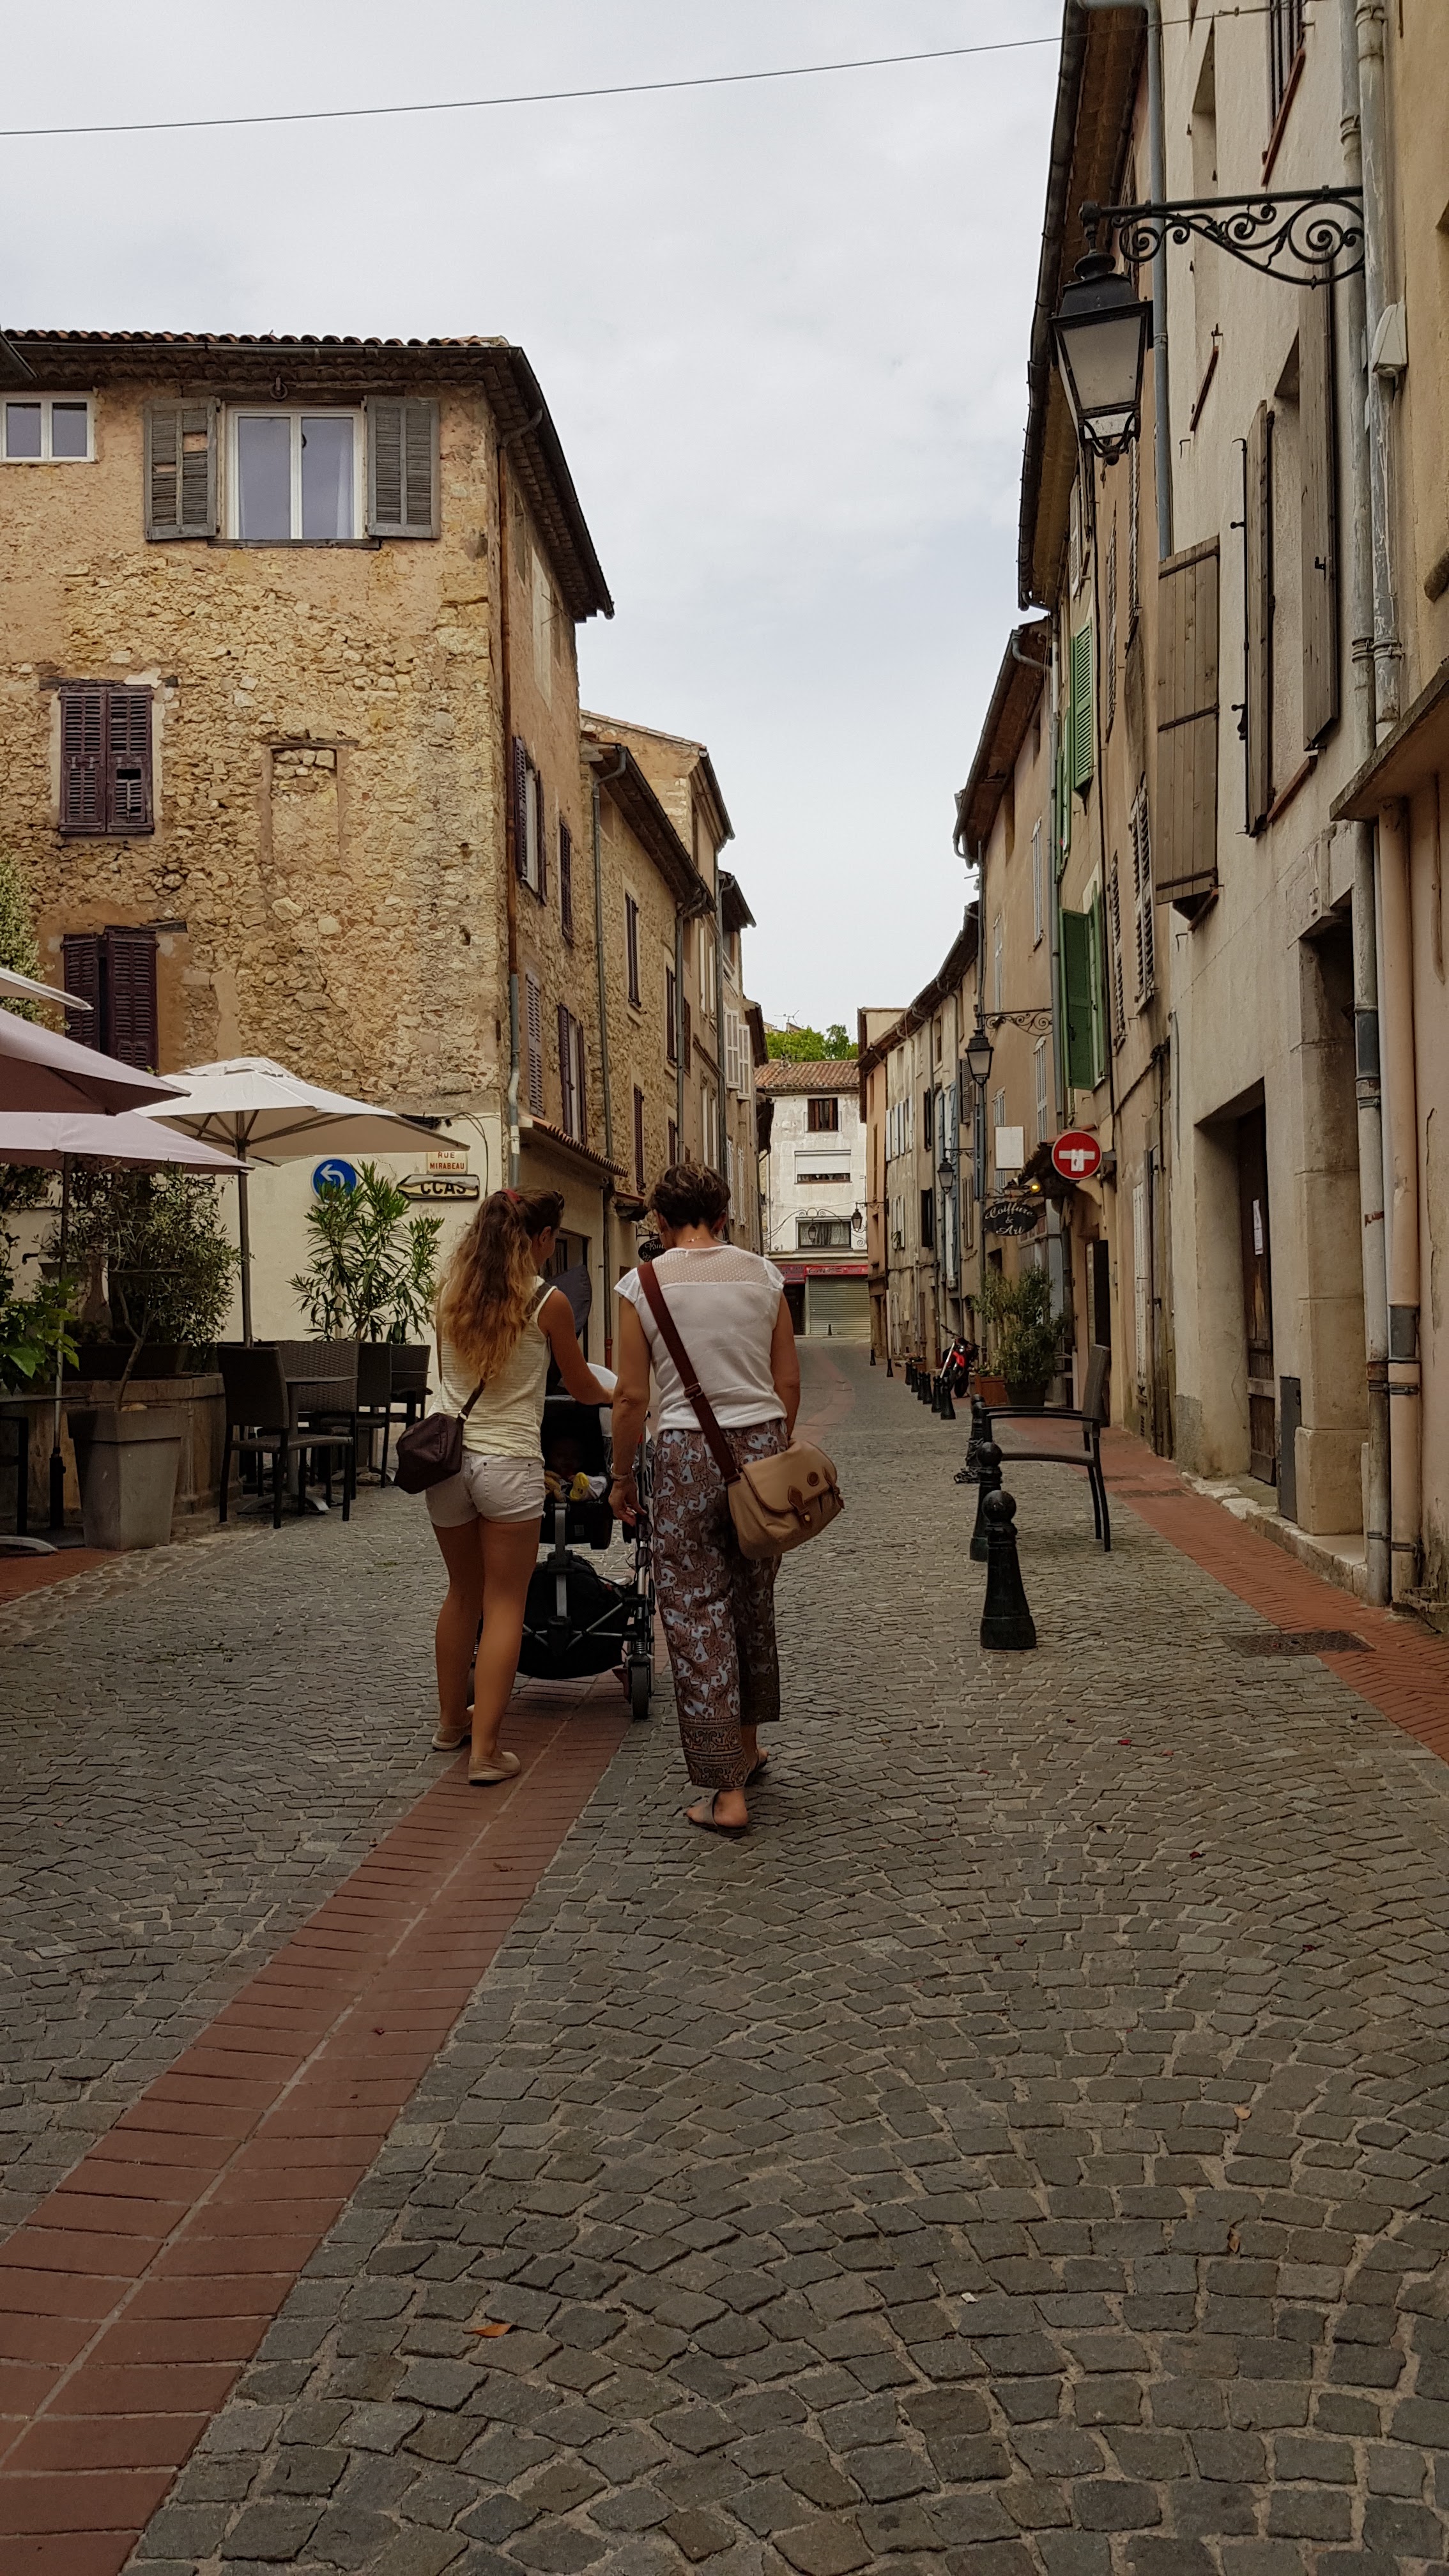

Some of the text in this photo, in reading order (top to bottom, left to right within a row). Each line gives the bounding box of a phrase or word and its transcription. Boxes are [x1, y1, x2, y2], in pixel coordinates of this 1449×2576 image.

[985, 1202, 1035, 1220] Coiffure
[1005, 1216, 1014, 1224] &
[995, 1225, 1024, 1235] Art
